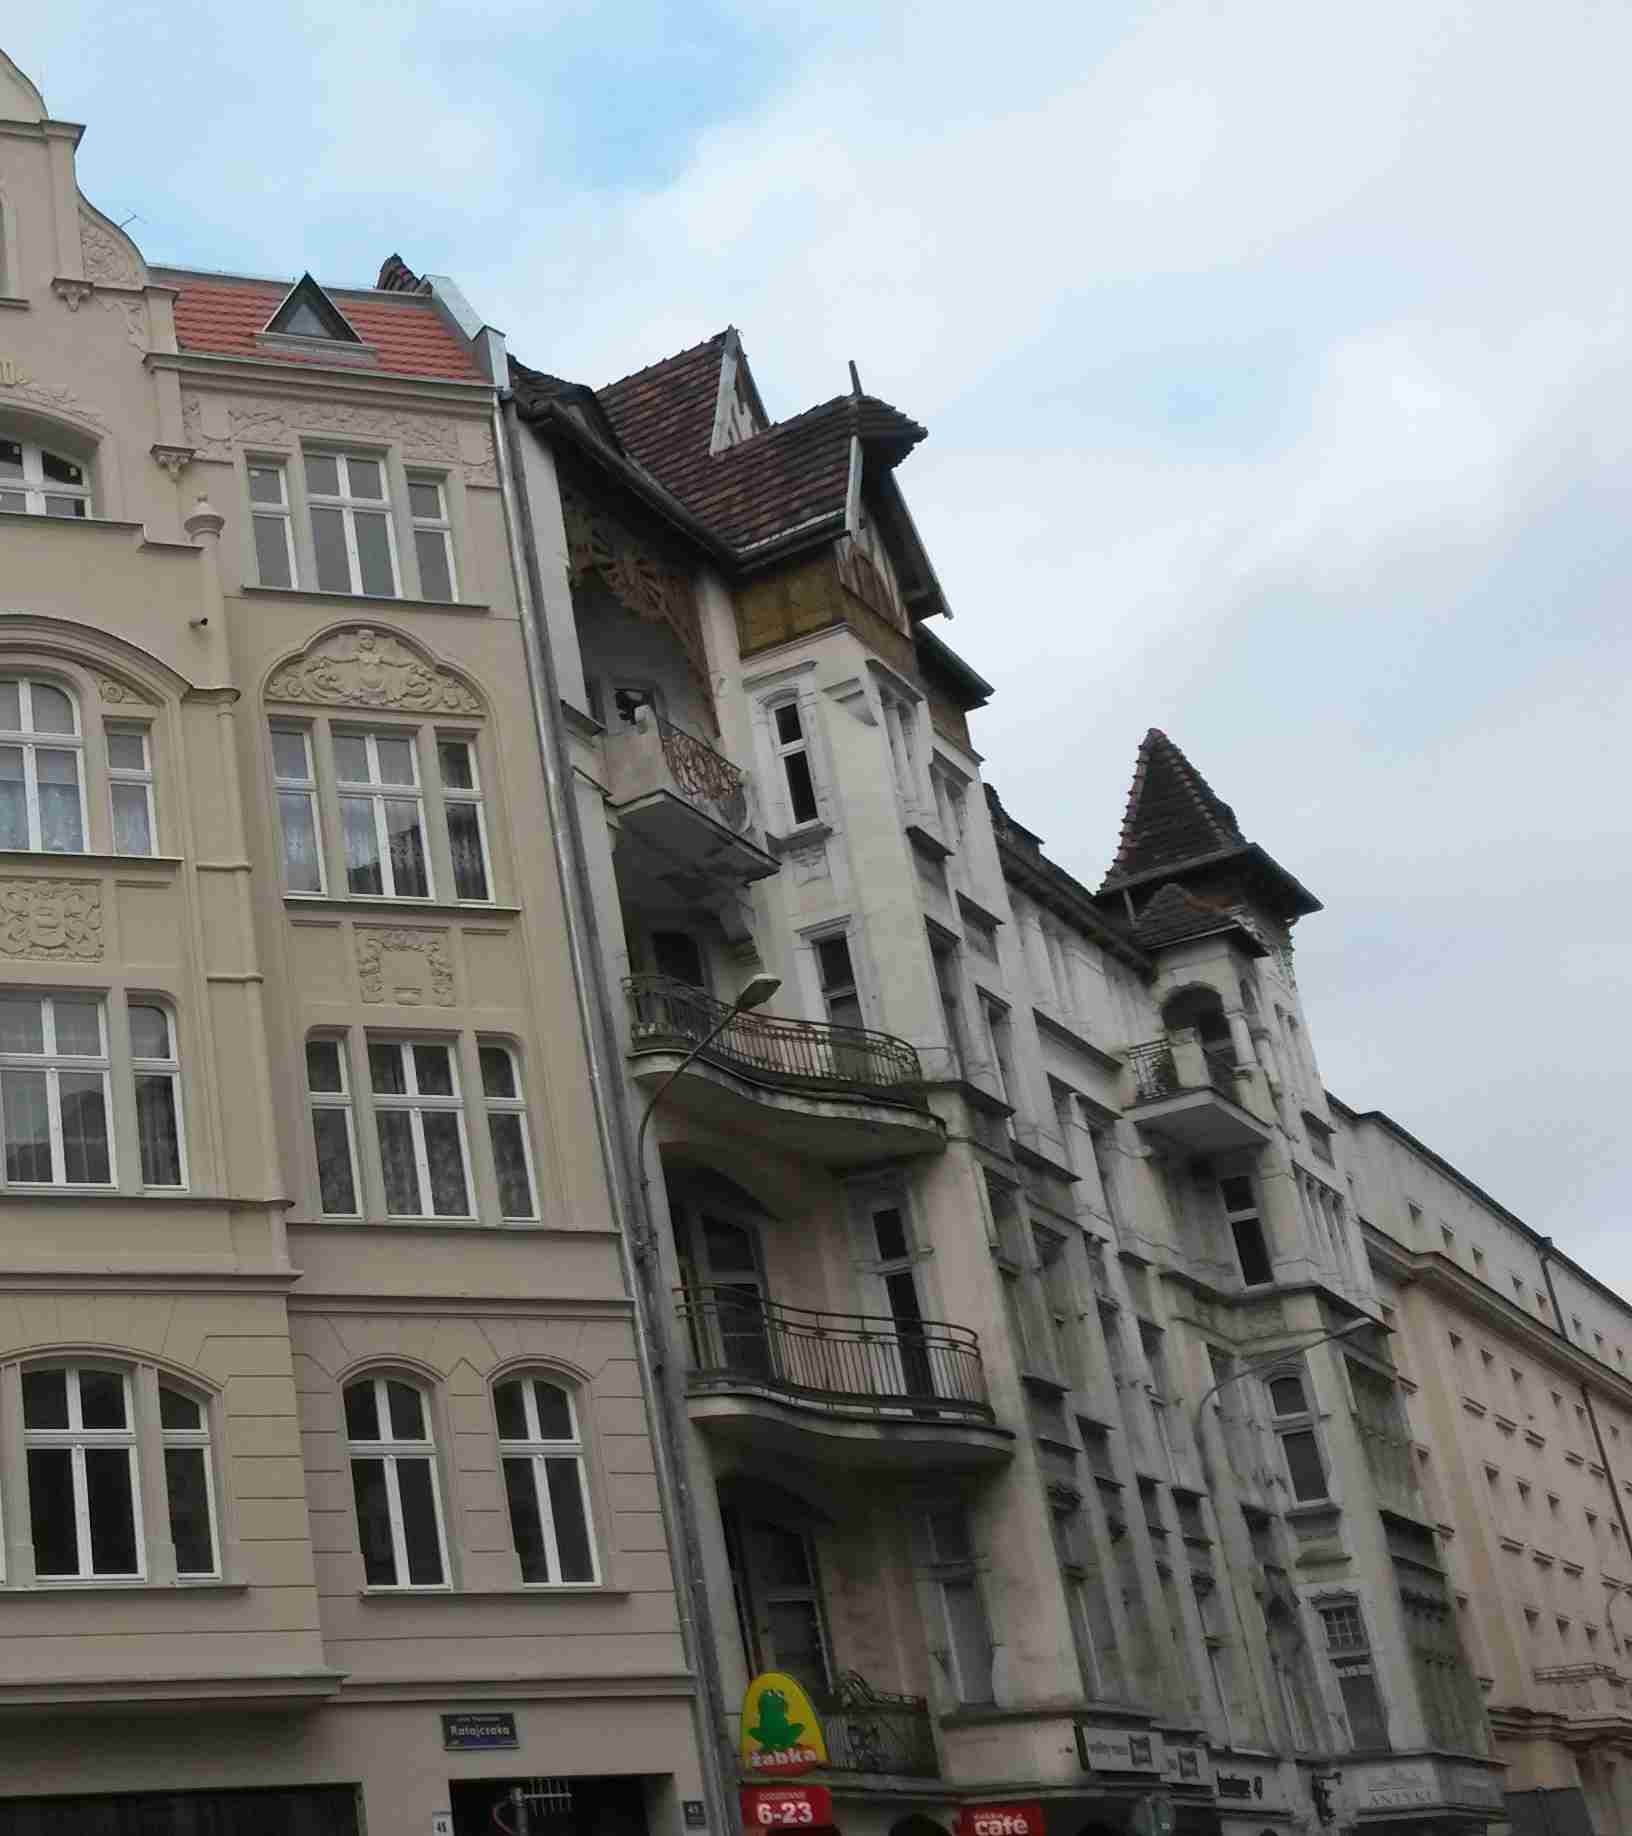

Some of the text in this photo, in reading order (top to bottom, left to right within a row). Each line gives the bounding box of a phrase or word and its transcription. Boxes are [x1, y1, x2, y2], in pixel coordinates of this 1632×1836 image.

[751, 1747, 818, 1766] żabka
[756, 1801, 814, 1824] 6-23
[974, 1813, 1029, 1836] café
